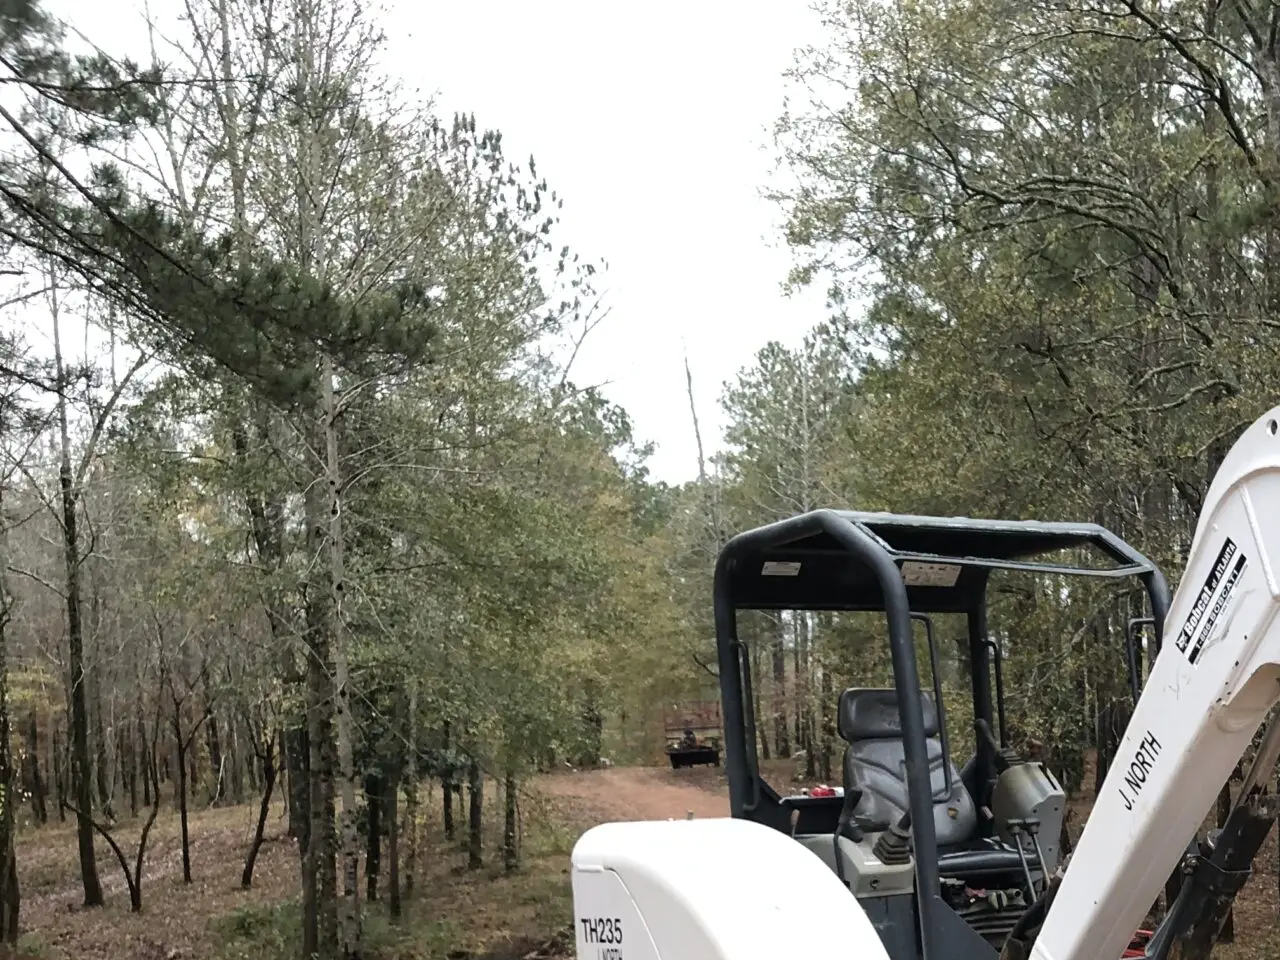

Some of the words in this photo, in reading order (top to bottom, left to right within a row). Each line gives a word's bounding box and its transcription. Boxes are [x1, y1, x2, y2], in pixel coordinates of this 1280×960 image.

[1183, 585, 1213, 637] Bobcat
[1214, 542, 1236, 580] ATLANTA
[1124, 729, 1162, 796] NORTH
[1119, 788, 1135, 811] J.
[581, 918, 623, 944] TH235
